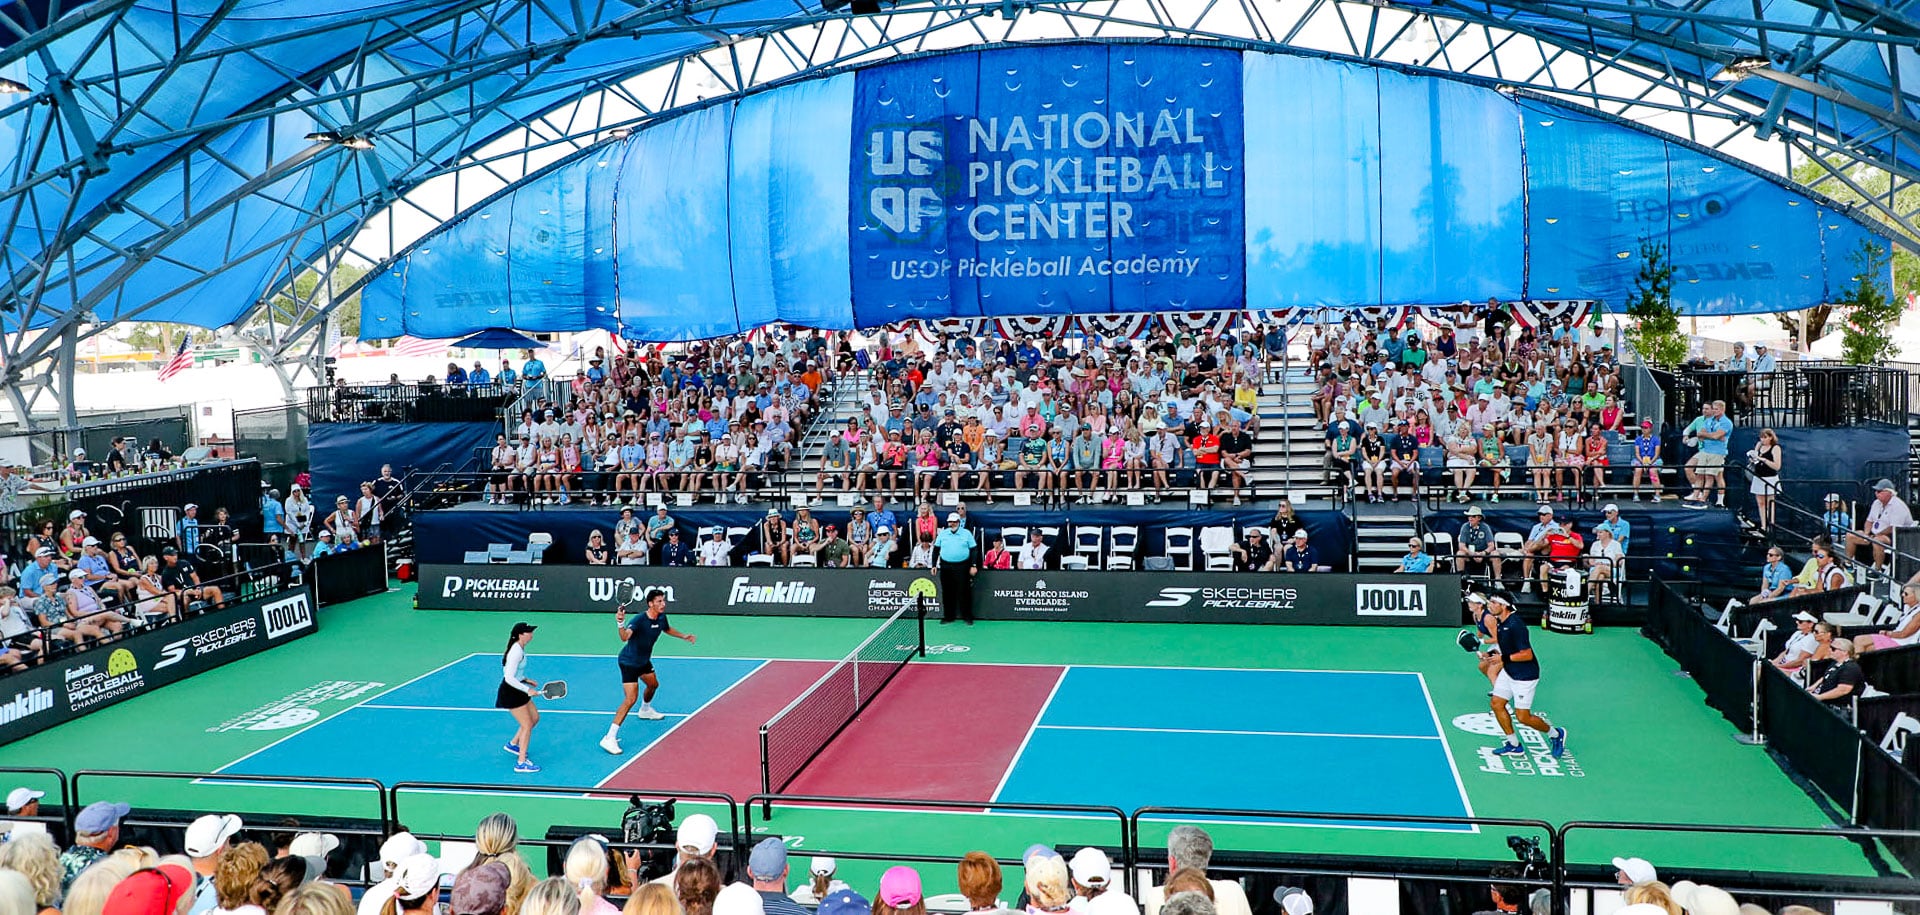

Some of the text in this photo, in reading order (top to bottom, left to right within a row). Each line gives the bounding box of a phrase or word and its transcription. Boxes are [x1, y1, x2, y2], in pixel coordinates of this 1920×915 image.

[969, 107, 1204, 153] NATIONAL
[871, 130, 942, 175] US
[969, 151, 1223, 198] PICKLEBALL
[968, 200, 1135, 241] CENTER
[957, 256, 1071, 279] Pickleball
[1078, 254, 1199, 278] Academy
[465, 578, 540, 591] PICKLEBALL
[472, 591, 531, 599] WAREHOUSE
[588, 577, 676, 601] Wson
[994, 590, 1089, 599] NAPLES MARCO ISLAND
[1202, 587, 1297, 600] SKECHERS
[1202, 599, 1295, 609] PICKLEBALL
[1360, 588, 1424, 611] JOOLA
[267, 600, 310, 633] JOOLA
[192, 617, 257, 647] SKECHERS
[195, 629, 257, 657] PICKLEBALL
[65, 670, 110, 693] US OPEN
[68, 670, 143, 704] PICKLEBALL
[0, 687, 53, 725] nklin
[71, 680, 145, 712] CHAMPIONSHIPS
